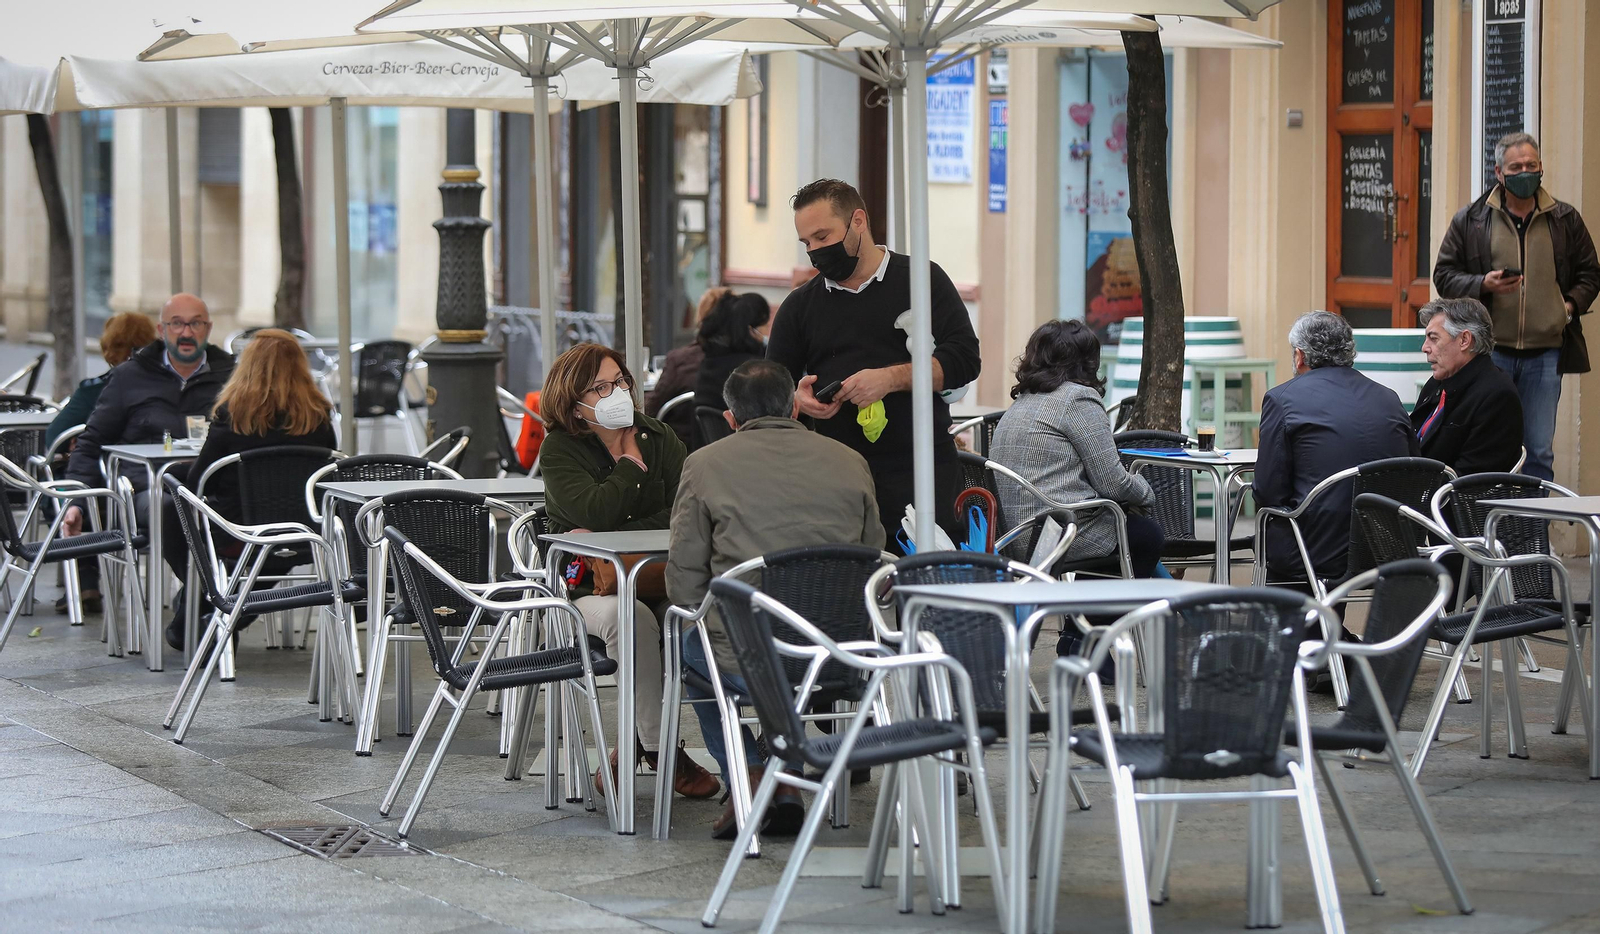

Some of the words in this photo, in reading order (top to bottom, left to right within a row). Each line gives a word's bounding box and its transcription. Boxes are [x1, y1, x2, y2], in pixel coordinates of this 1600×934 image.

[322, 61, 500, 83] Cerveza-Bier-Beer-Cerveja
[1350, 162, 1383, 180] TARTAS
[1350, 195, 1395, 216] ROSQUILLS
